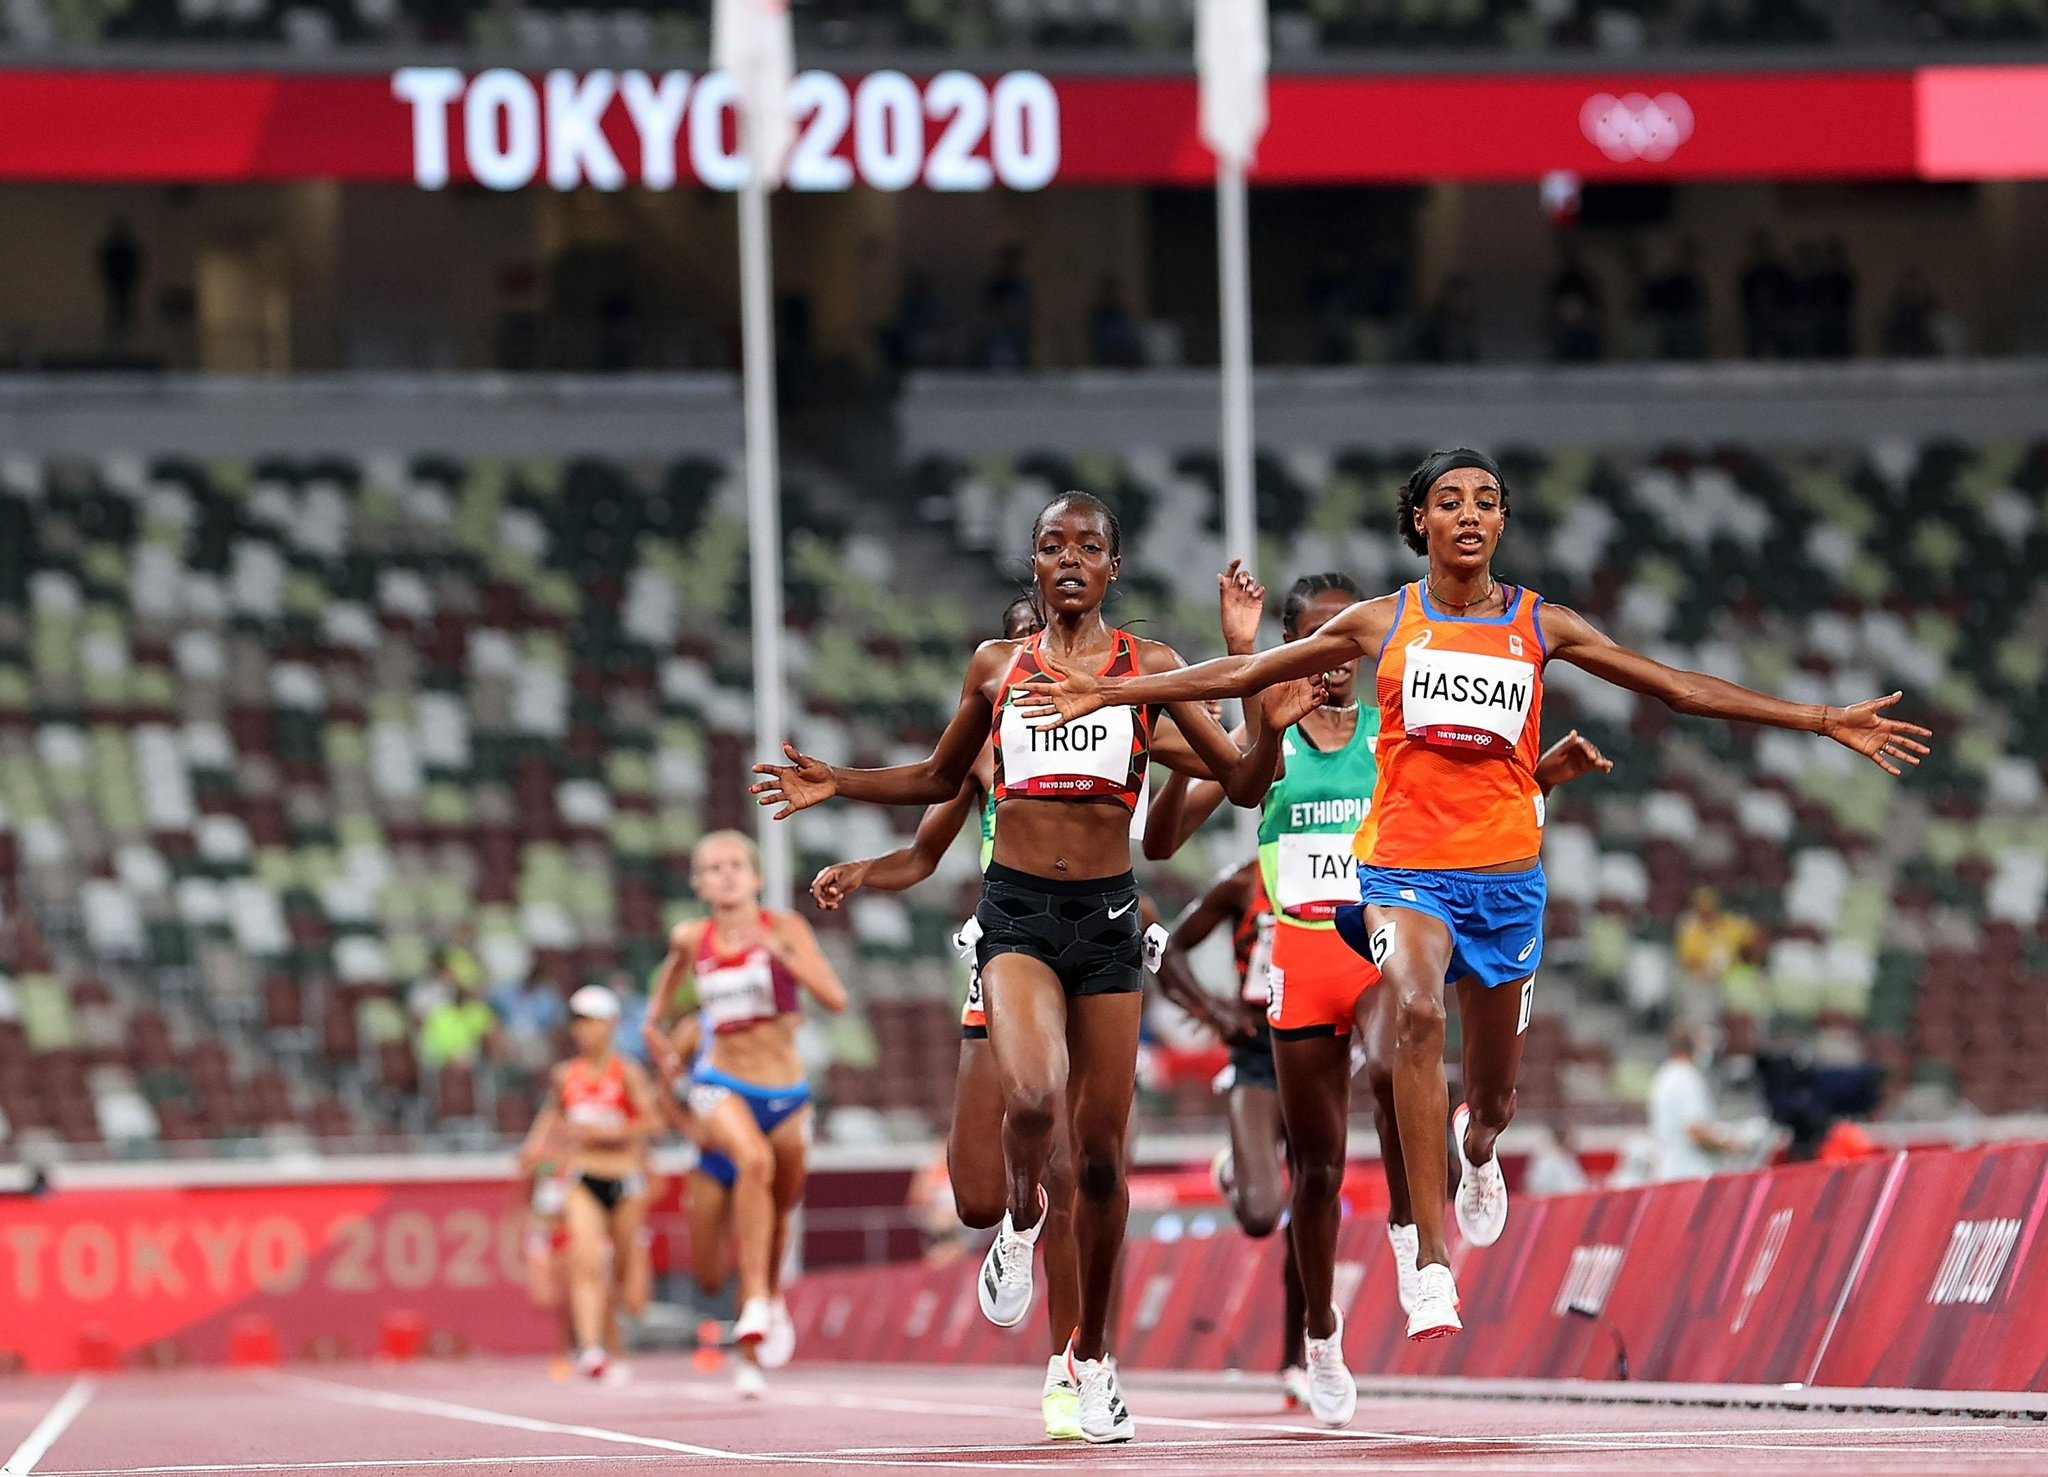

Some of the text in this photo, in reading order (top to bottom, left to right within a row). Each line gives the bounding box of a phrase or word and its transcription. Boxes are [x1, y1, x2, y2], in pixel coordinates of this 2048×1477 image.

[391, 67, 1062, 192] TOKYO 2020
[1411, 671, 1526, 713] HASSAN
[1026, 725, 1108, 752] TIROP
[1437, 731, 1473, 741] TOKYO 2020
[1308, 854, 1359, 879] TAY
[4, 1214, 308, 1300] TOKYO
